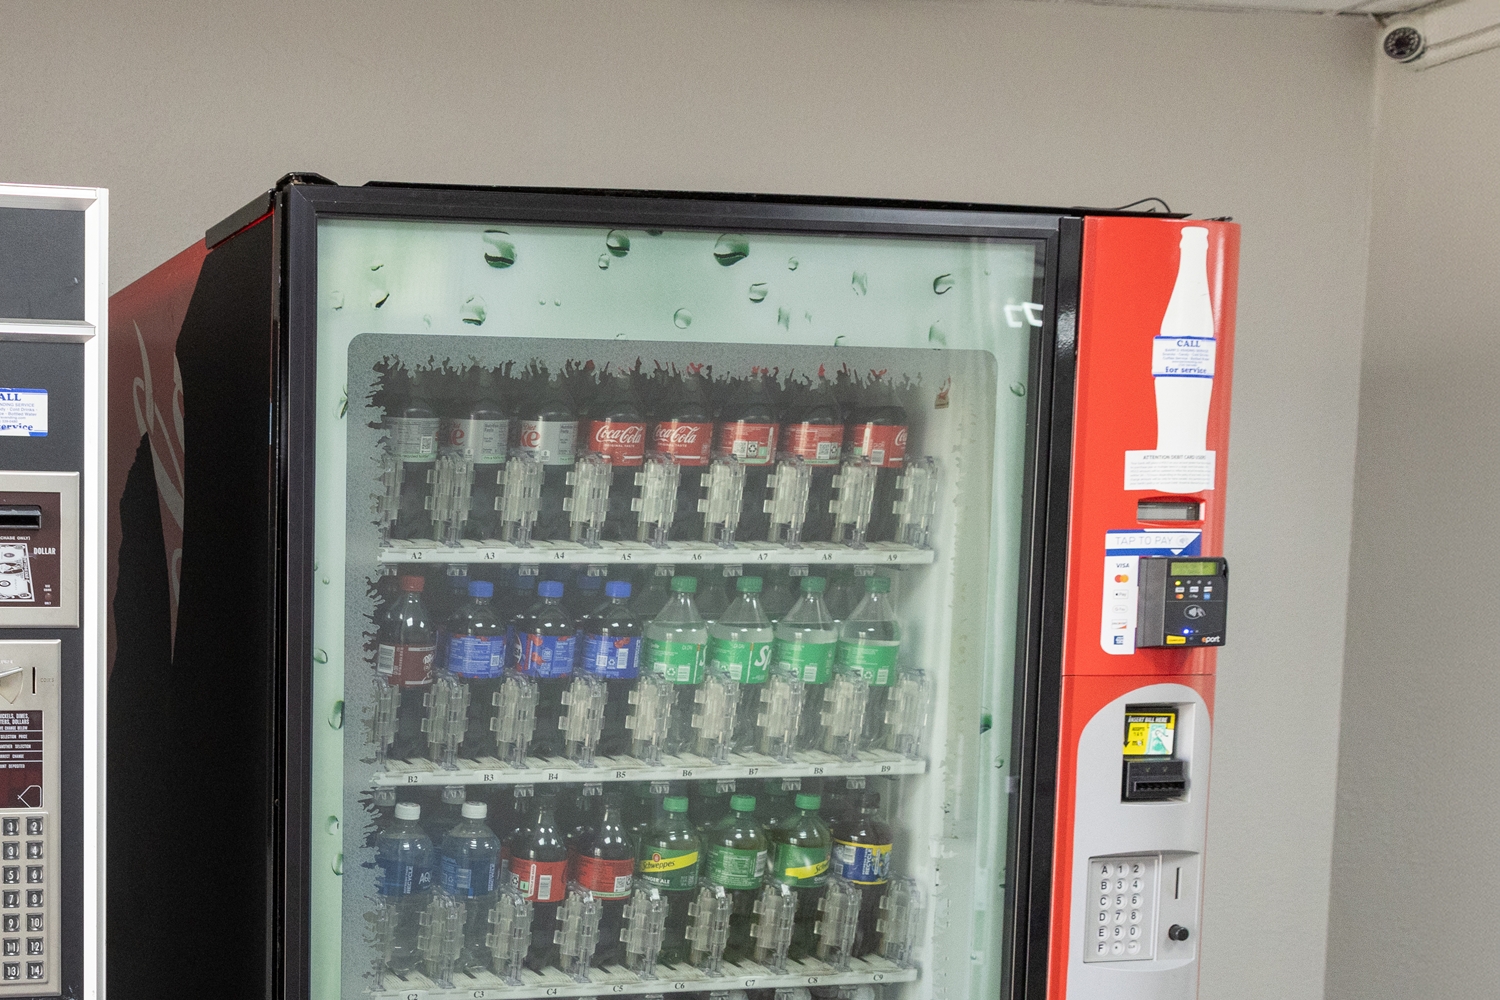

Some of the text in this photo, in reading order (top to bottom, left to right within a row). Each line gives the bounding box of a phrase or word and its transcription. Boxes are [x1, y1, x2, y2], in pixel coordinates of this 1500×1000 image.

[1177, 340, 1200, 348] CALL
[1165, 366, 1207, 374] for service
[596, 424, 643, 444] Coca-Cola
[1115, 536, 1173, 545] TAP TO PAY
[33, 547, 56, 555] DOLLAR
[31, 918, 40, 927] 10
[31, 942, 40, 951] 12
[7, 967, 16, 976] 13
[31, 966, 40, 975] 14
